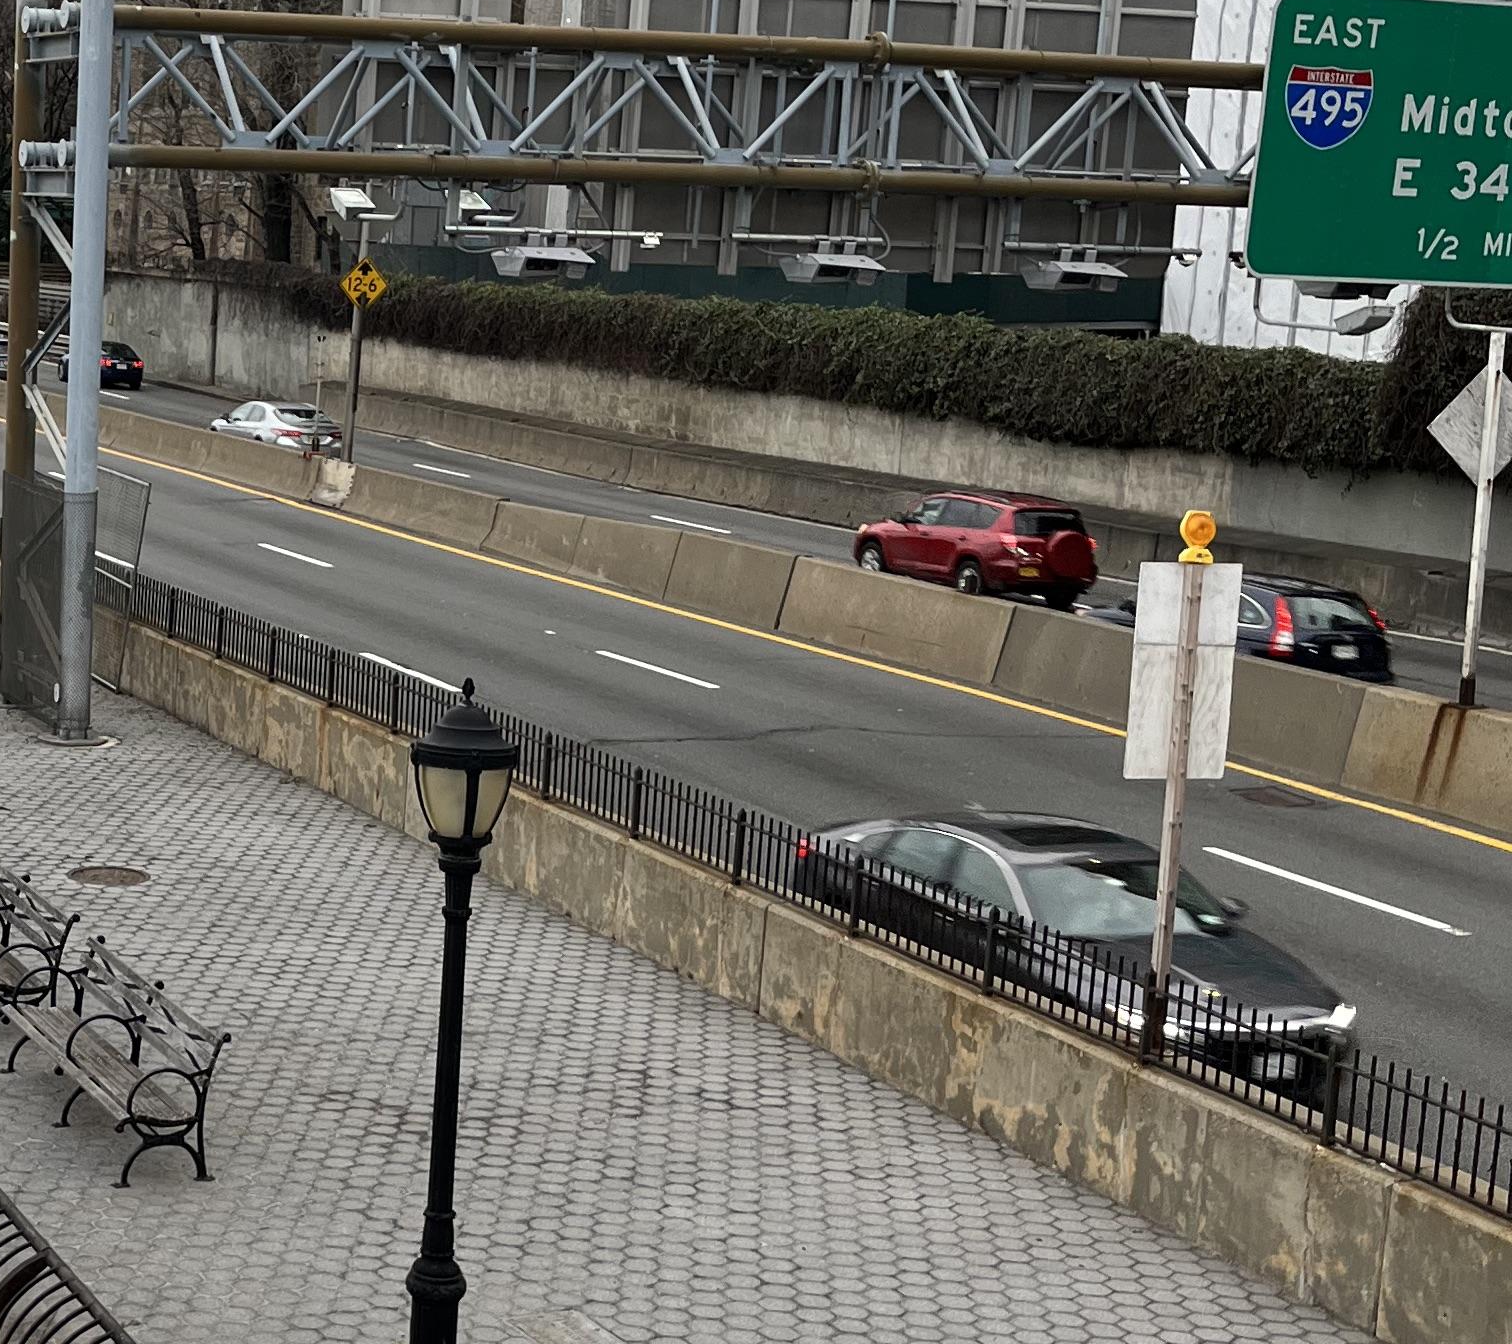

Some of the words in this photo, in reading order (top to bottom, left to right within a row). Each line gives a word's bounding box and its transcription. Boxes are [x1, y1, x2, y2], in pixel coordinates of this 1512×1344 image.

[1292, 13, 1386, 49] EAST
[1307, 70, 1355, 85] INTERSTATE
[1290, 88, 1365, 129] 495
[1391, 158, 1422, 197] E
[1449, 159, 1510, 202] 34
[1416, 227, 1460, 261] 1/2
